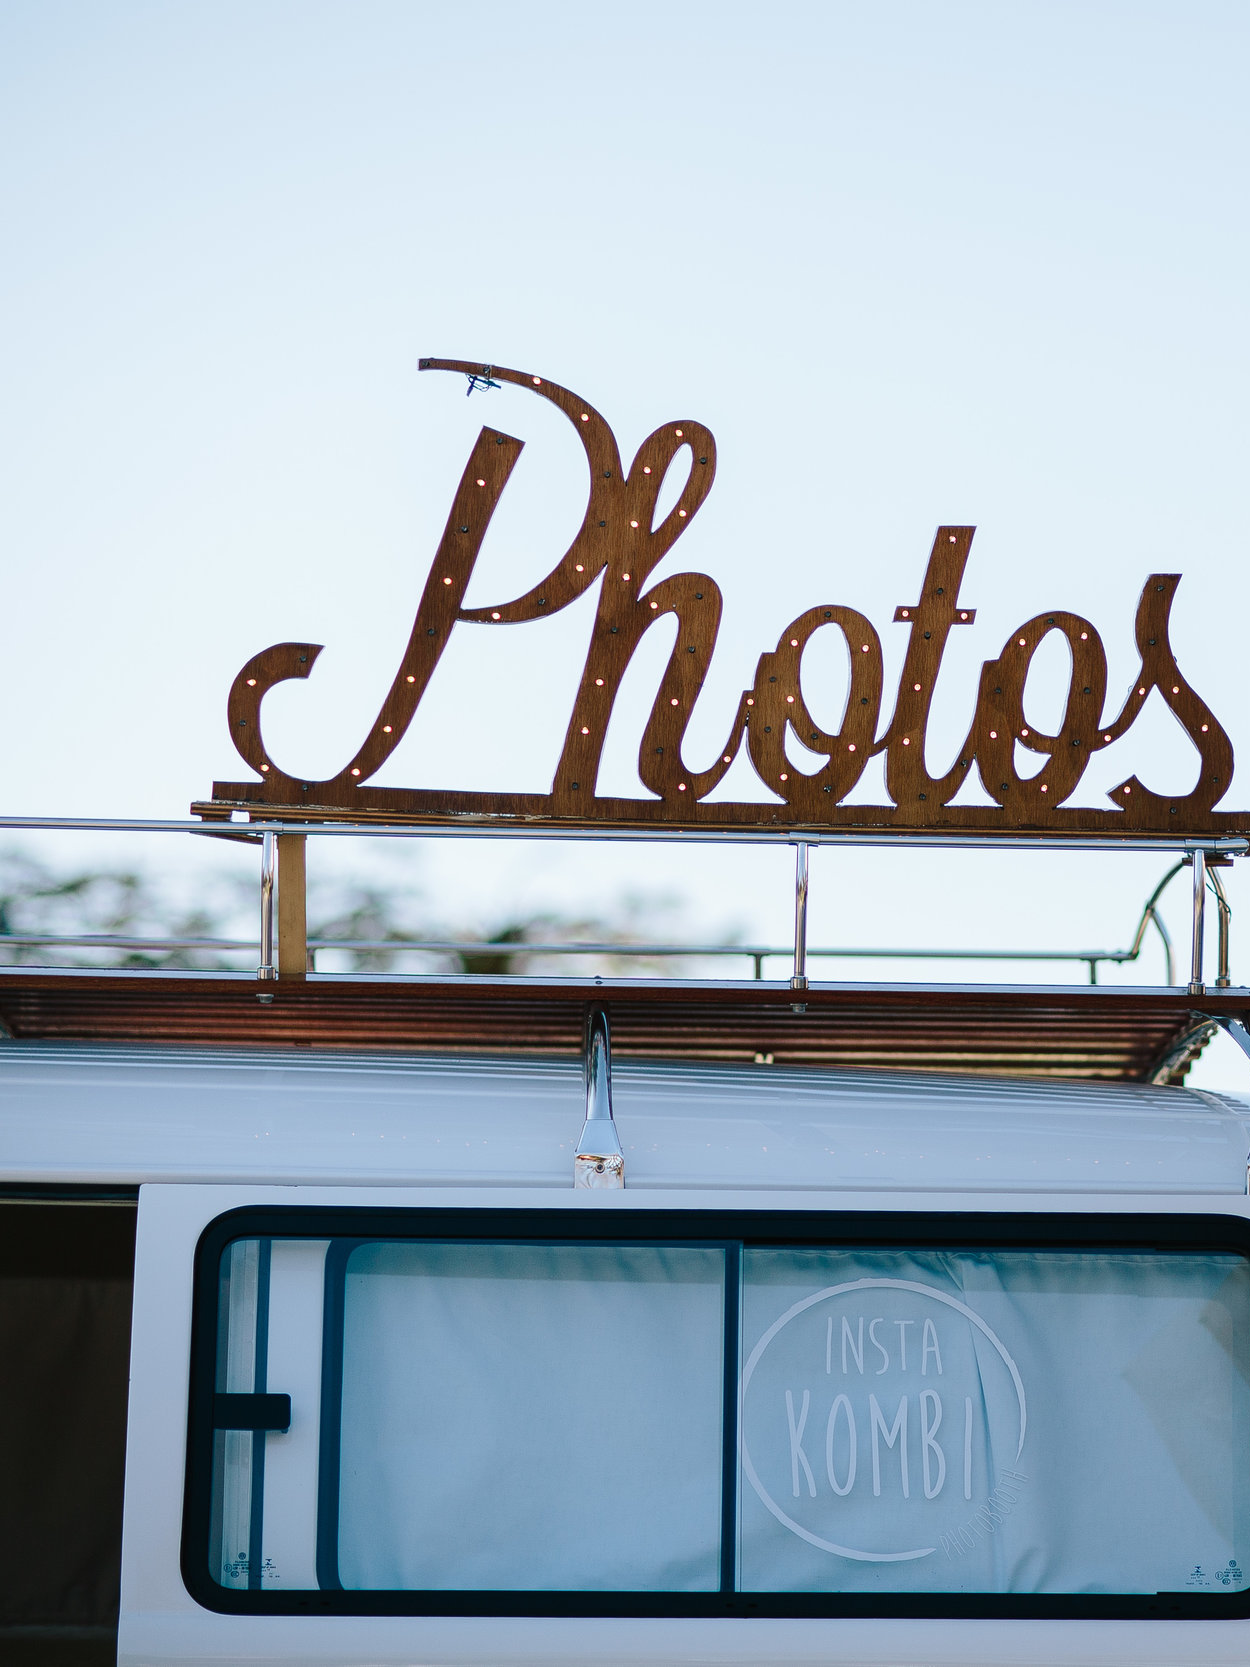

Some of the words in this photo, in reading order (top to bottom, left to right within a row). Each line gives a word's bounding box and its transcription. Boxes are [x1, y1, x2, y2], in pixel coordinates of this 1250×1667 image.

[227, 358, 1235, 812] Photos
[826, 1316, 943, 1375] INSTA
[785, 1389, 973, 1500] KOMBI
[938, 1464, 1030, 1561] PHOTOBOOTH
